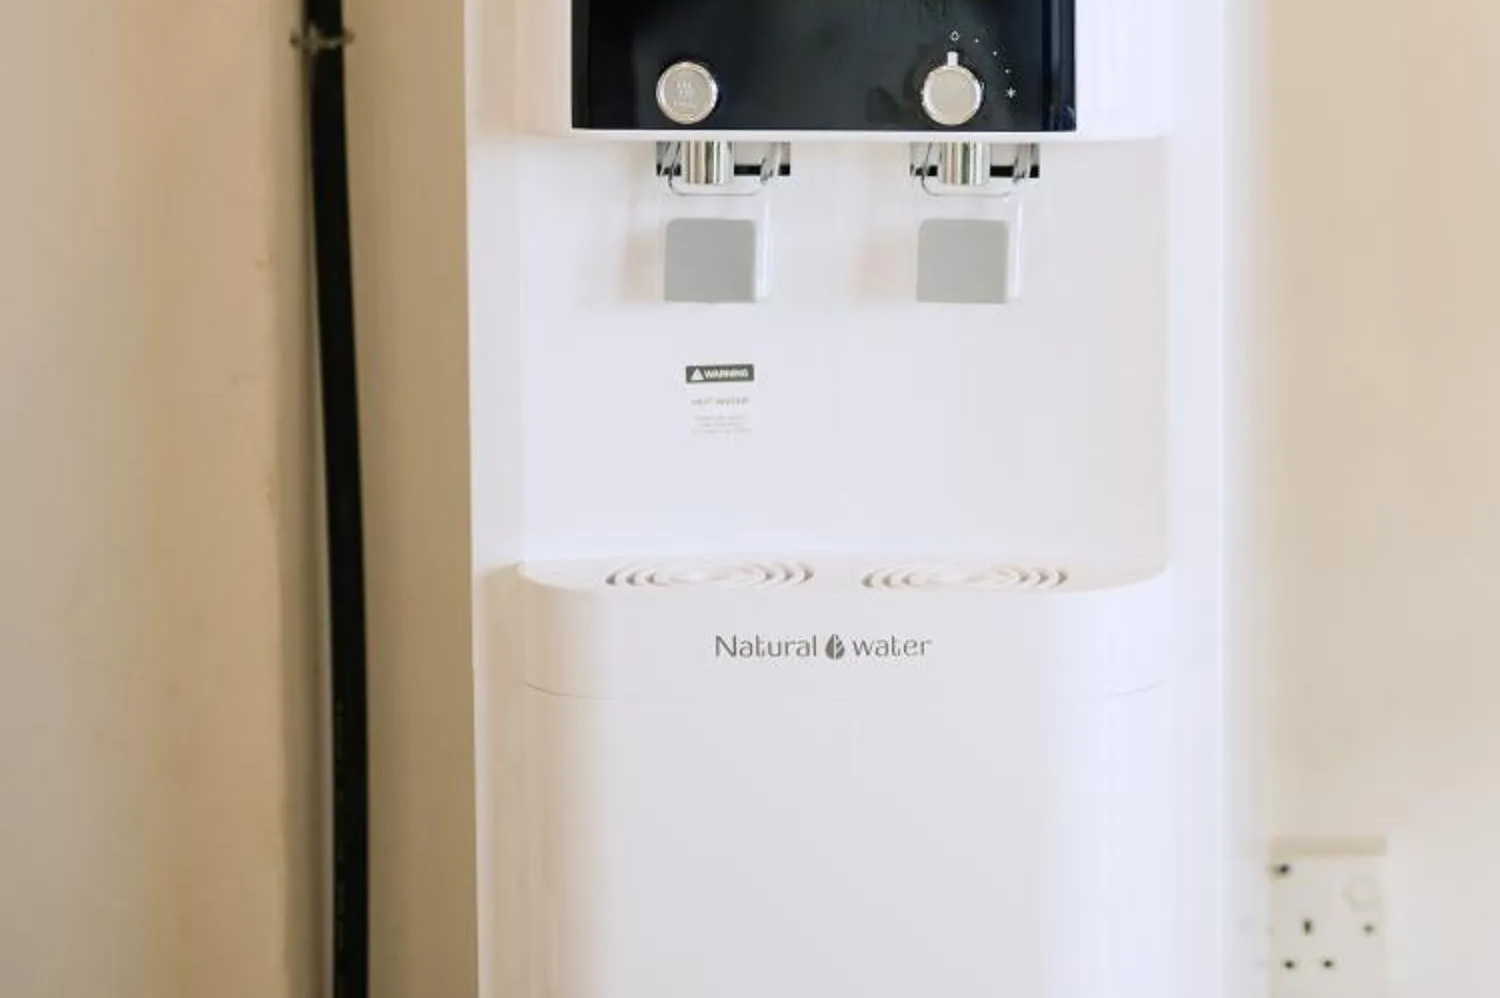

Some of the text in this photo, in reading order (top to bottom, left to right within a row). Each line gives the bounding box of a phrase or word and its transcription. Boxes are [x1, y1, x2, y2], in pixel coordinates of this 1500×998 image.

[703, 368, 750, 379] WARNING
[715, 634, 933, 658] Natural water
